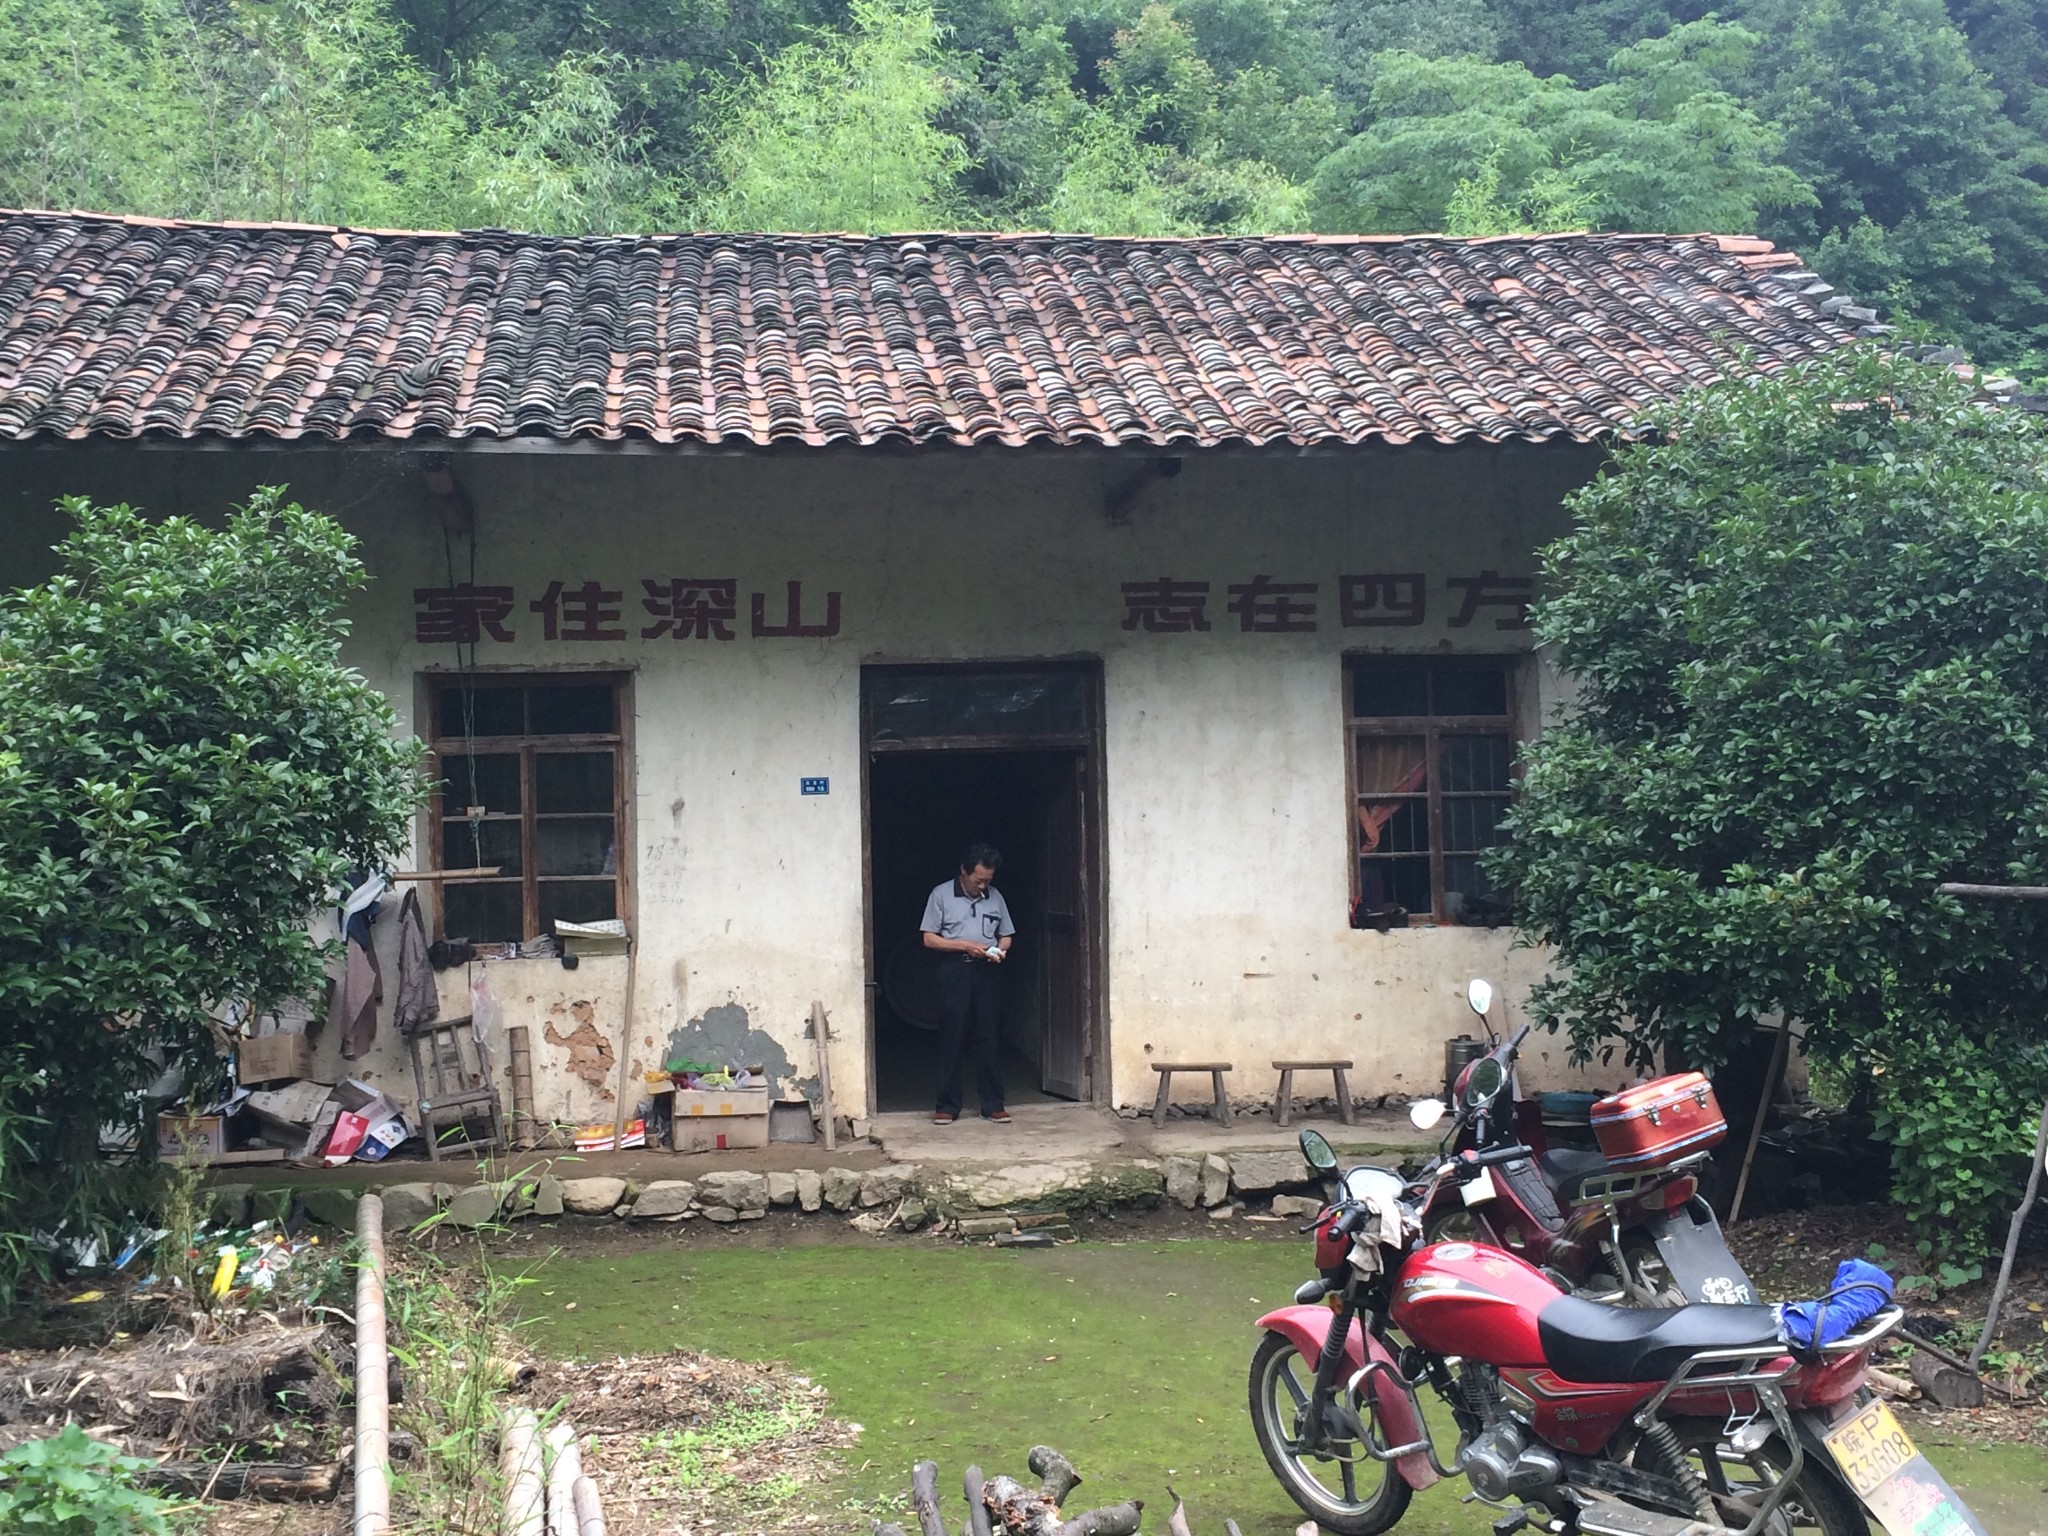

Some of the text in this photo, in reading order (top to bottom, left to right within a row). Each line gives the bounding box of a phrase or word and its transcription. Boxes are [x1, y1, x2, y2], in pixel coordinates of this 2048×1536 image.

[413, 578, 841, 643] 家住深山
[1120, 570, 1533, 633] 志在四方
